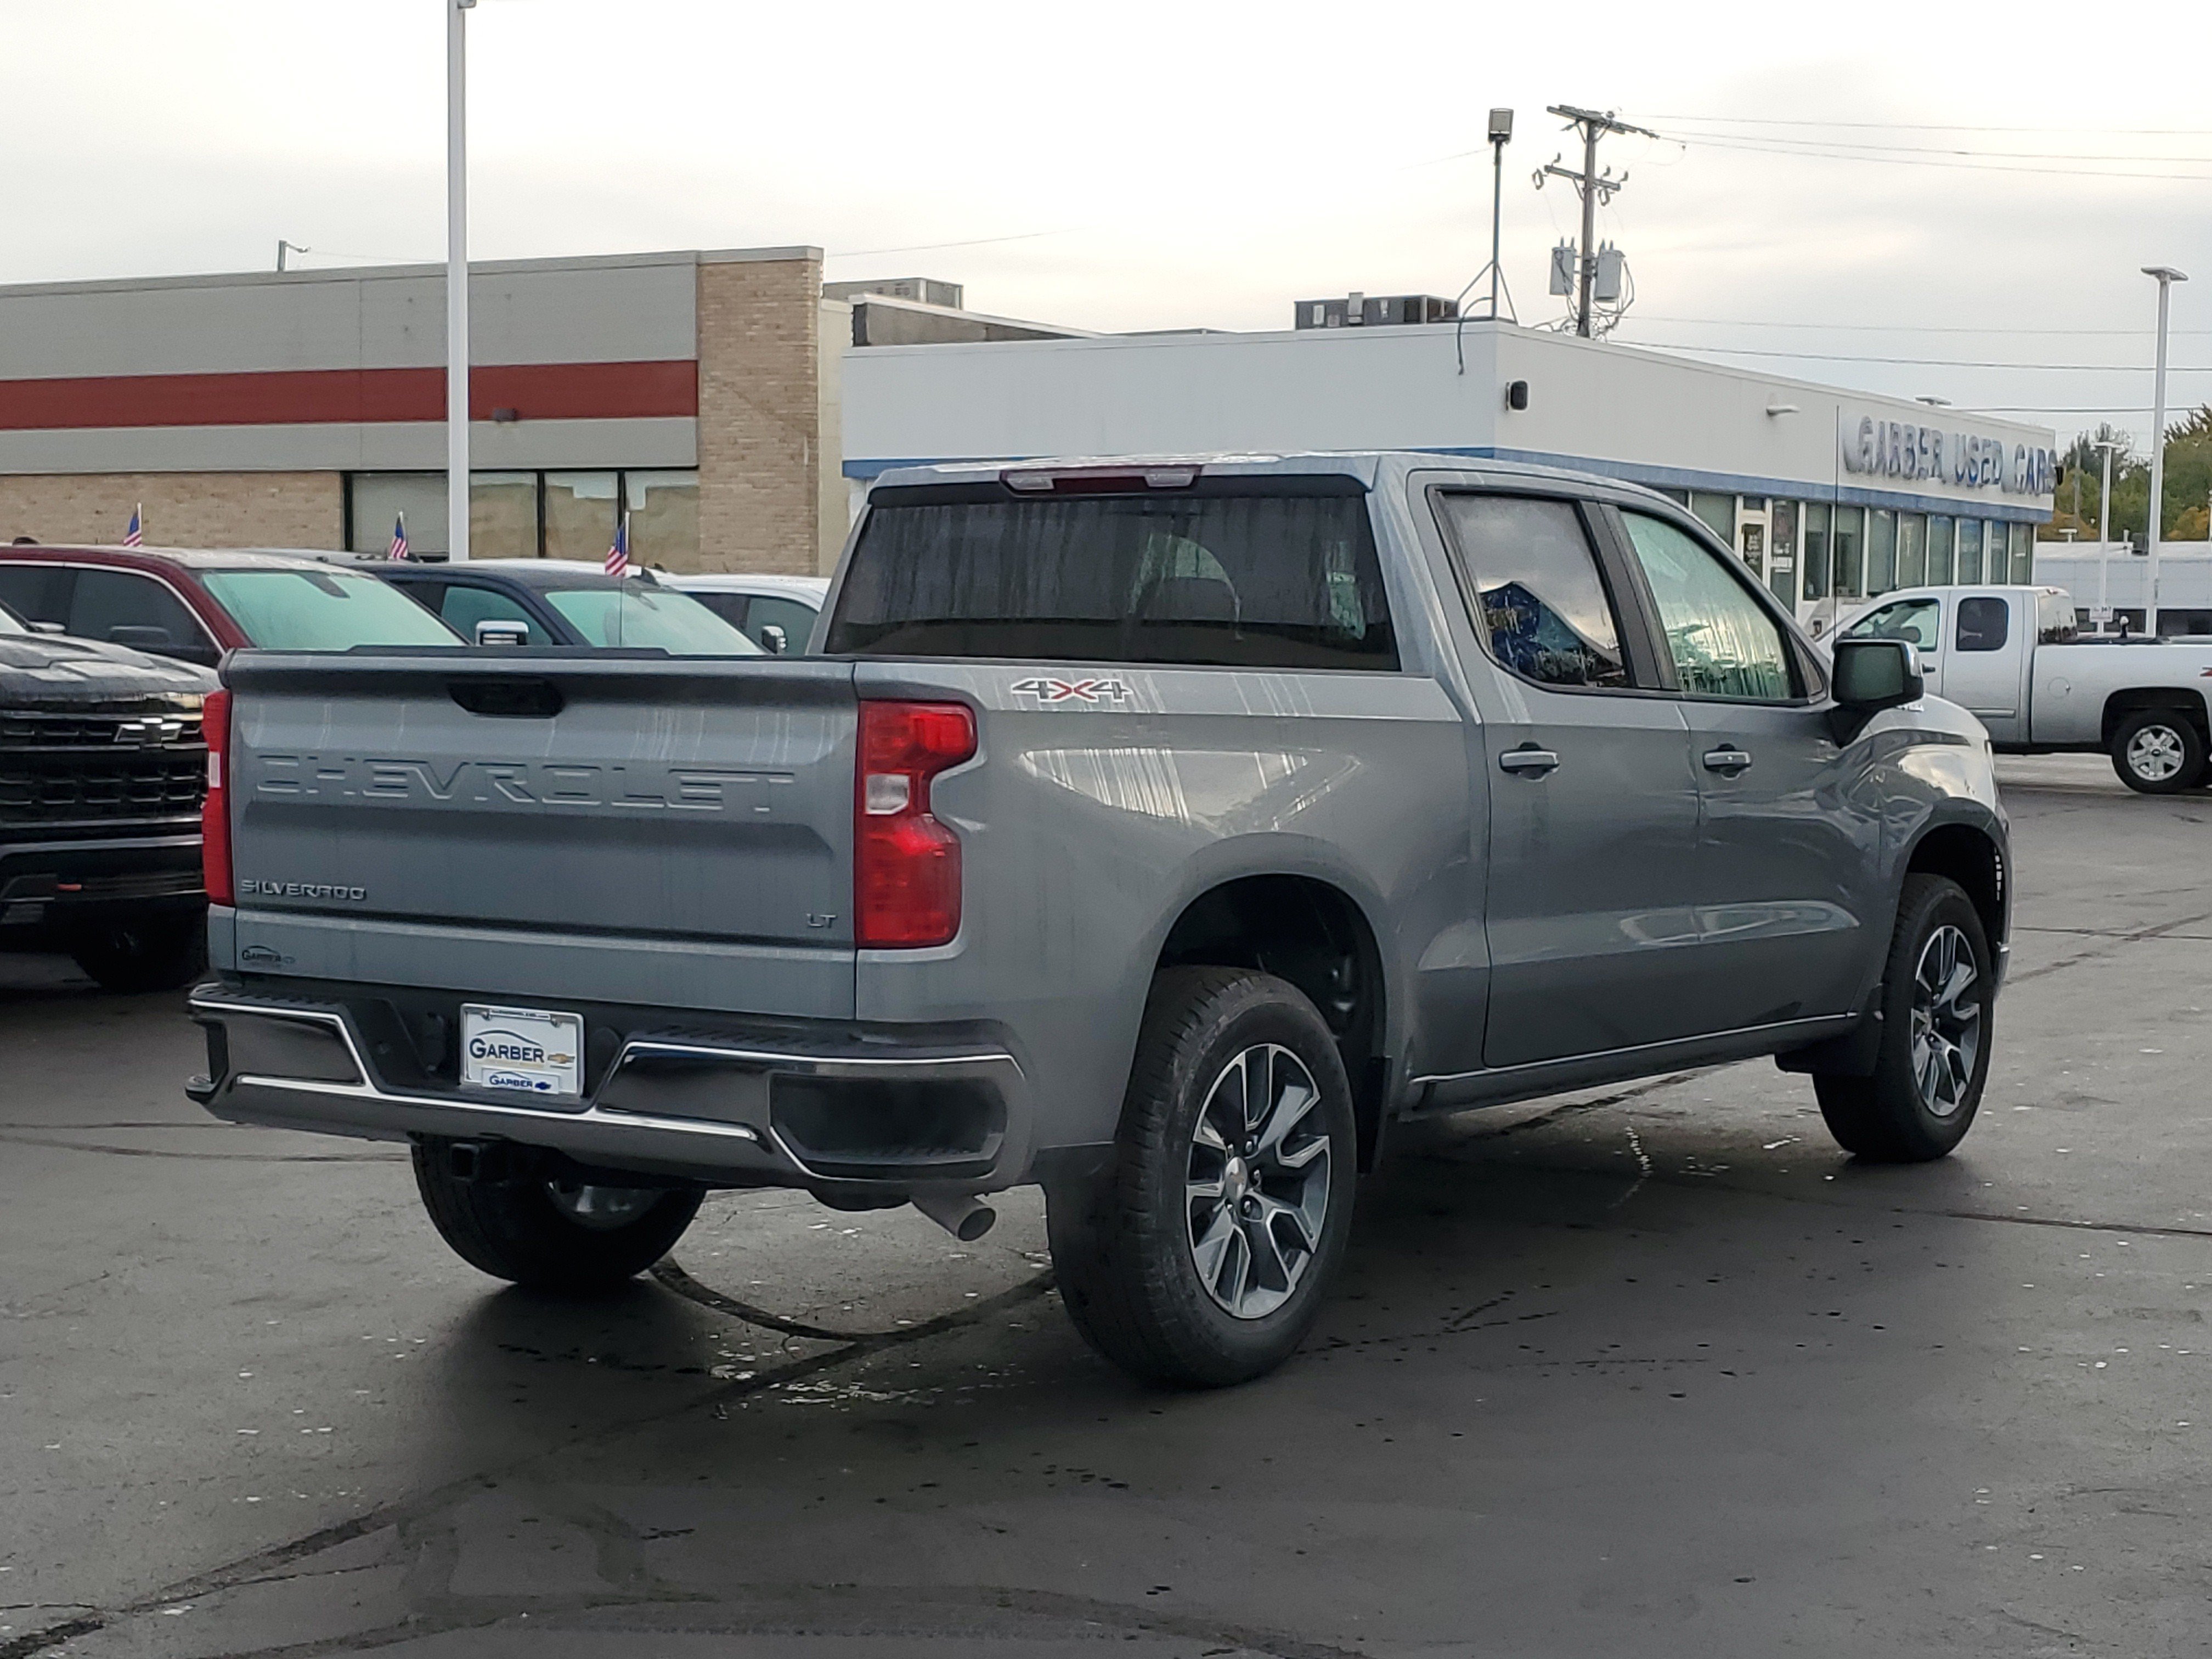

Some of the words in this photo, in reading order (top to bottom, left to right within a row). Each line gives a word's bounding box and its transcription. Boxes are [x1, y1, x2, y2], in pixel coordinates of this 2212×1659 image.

[1858, 415, 1944, 480] GARBER
[1955, 433, 2002, 486] USED
[2015, 444, 2057, 495] CARS
[257, 755, 795, 812] CHEVROLET
[241, 879, 365, 900] SILVERADO
[806, 913, 837, 928] LT
[470, 1038, 545, 1063] GARBER
[489, 1075, 533, 1087] GARBER
